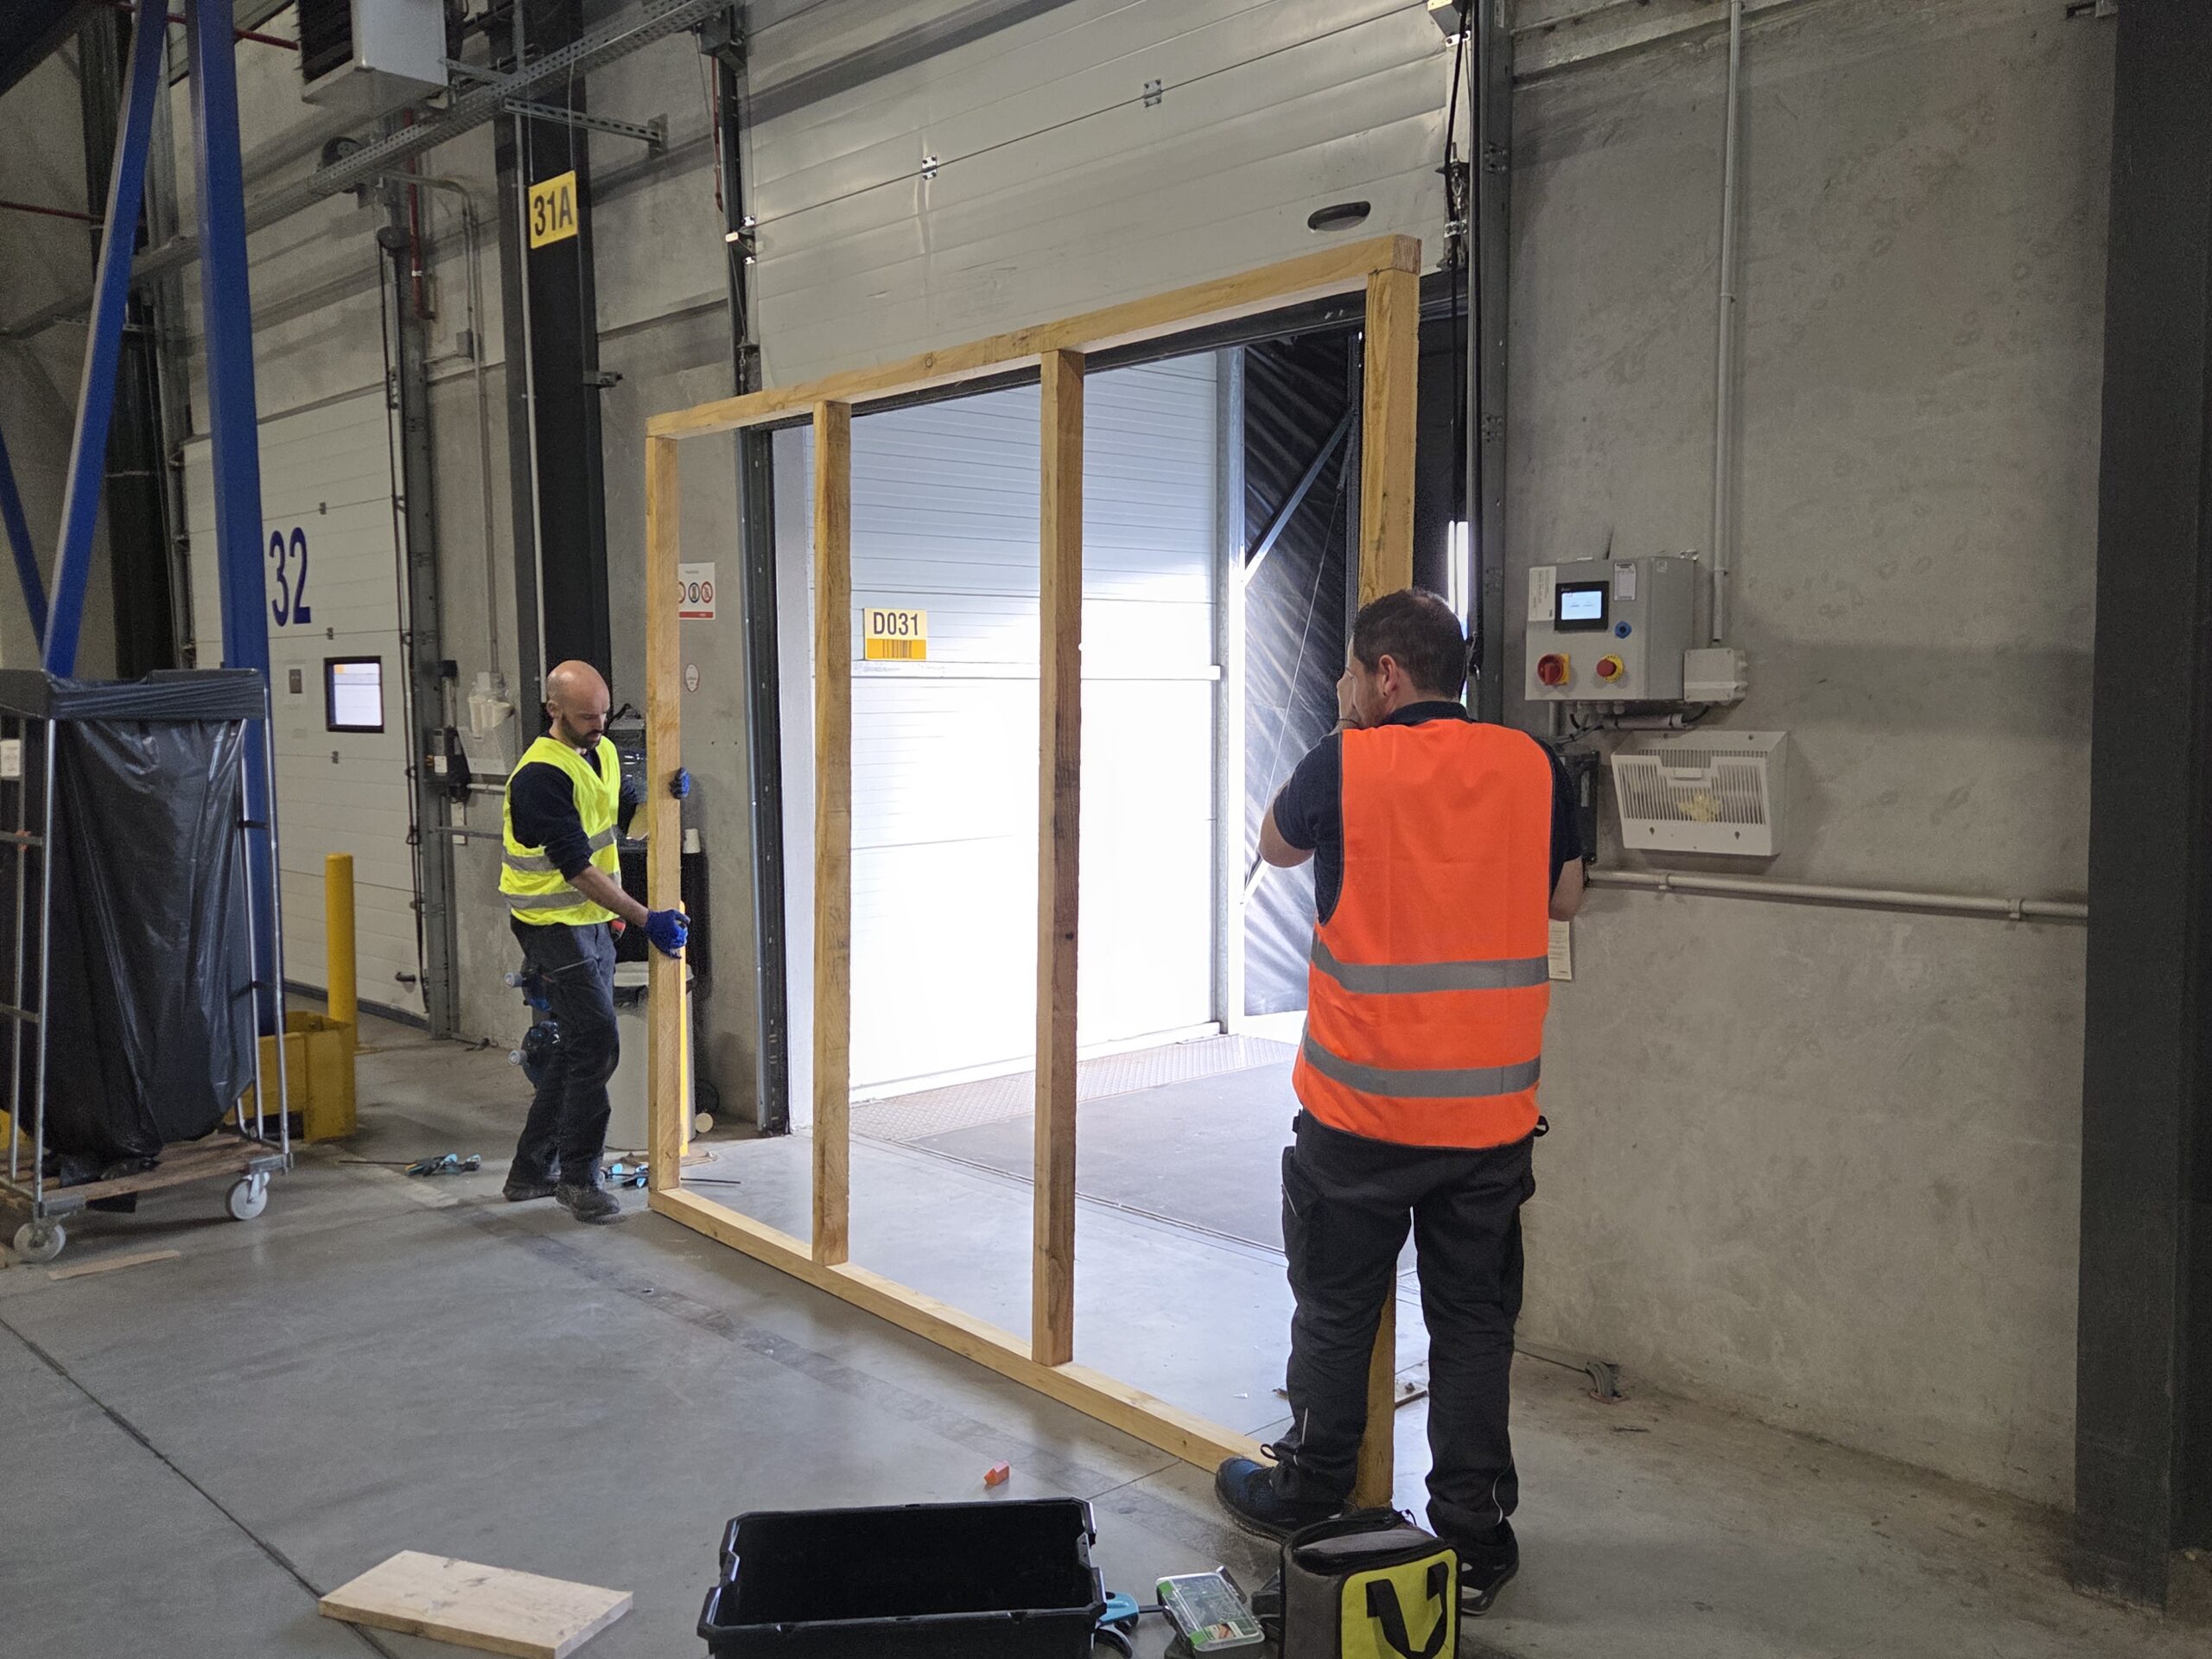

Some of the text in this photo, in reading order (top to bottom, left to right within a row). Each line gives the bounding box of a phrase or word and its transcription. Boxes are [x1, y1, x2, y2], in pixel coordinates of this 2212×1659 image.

[534, 186, 573, 237] 31A
[270, 527, 311, 627] 32
[874, 612, 918, 636] D031
